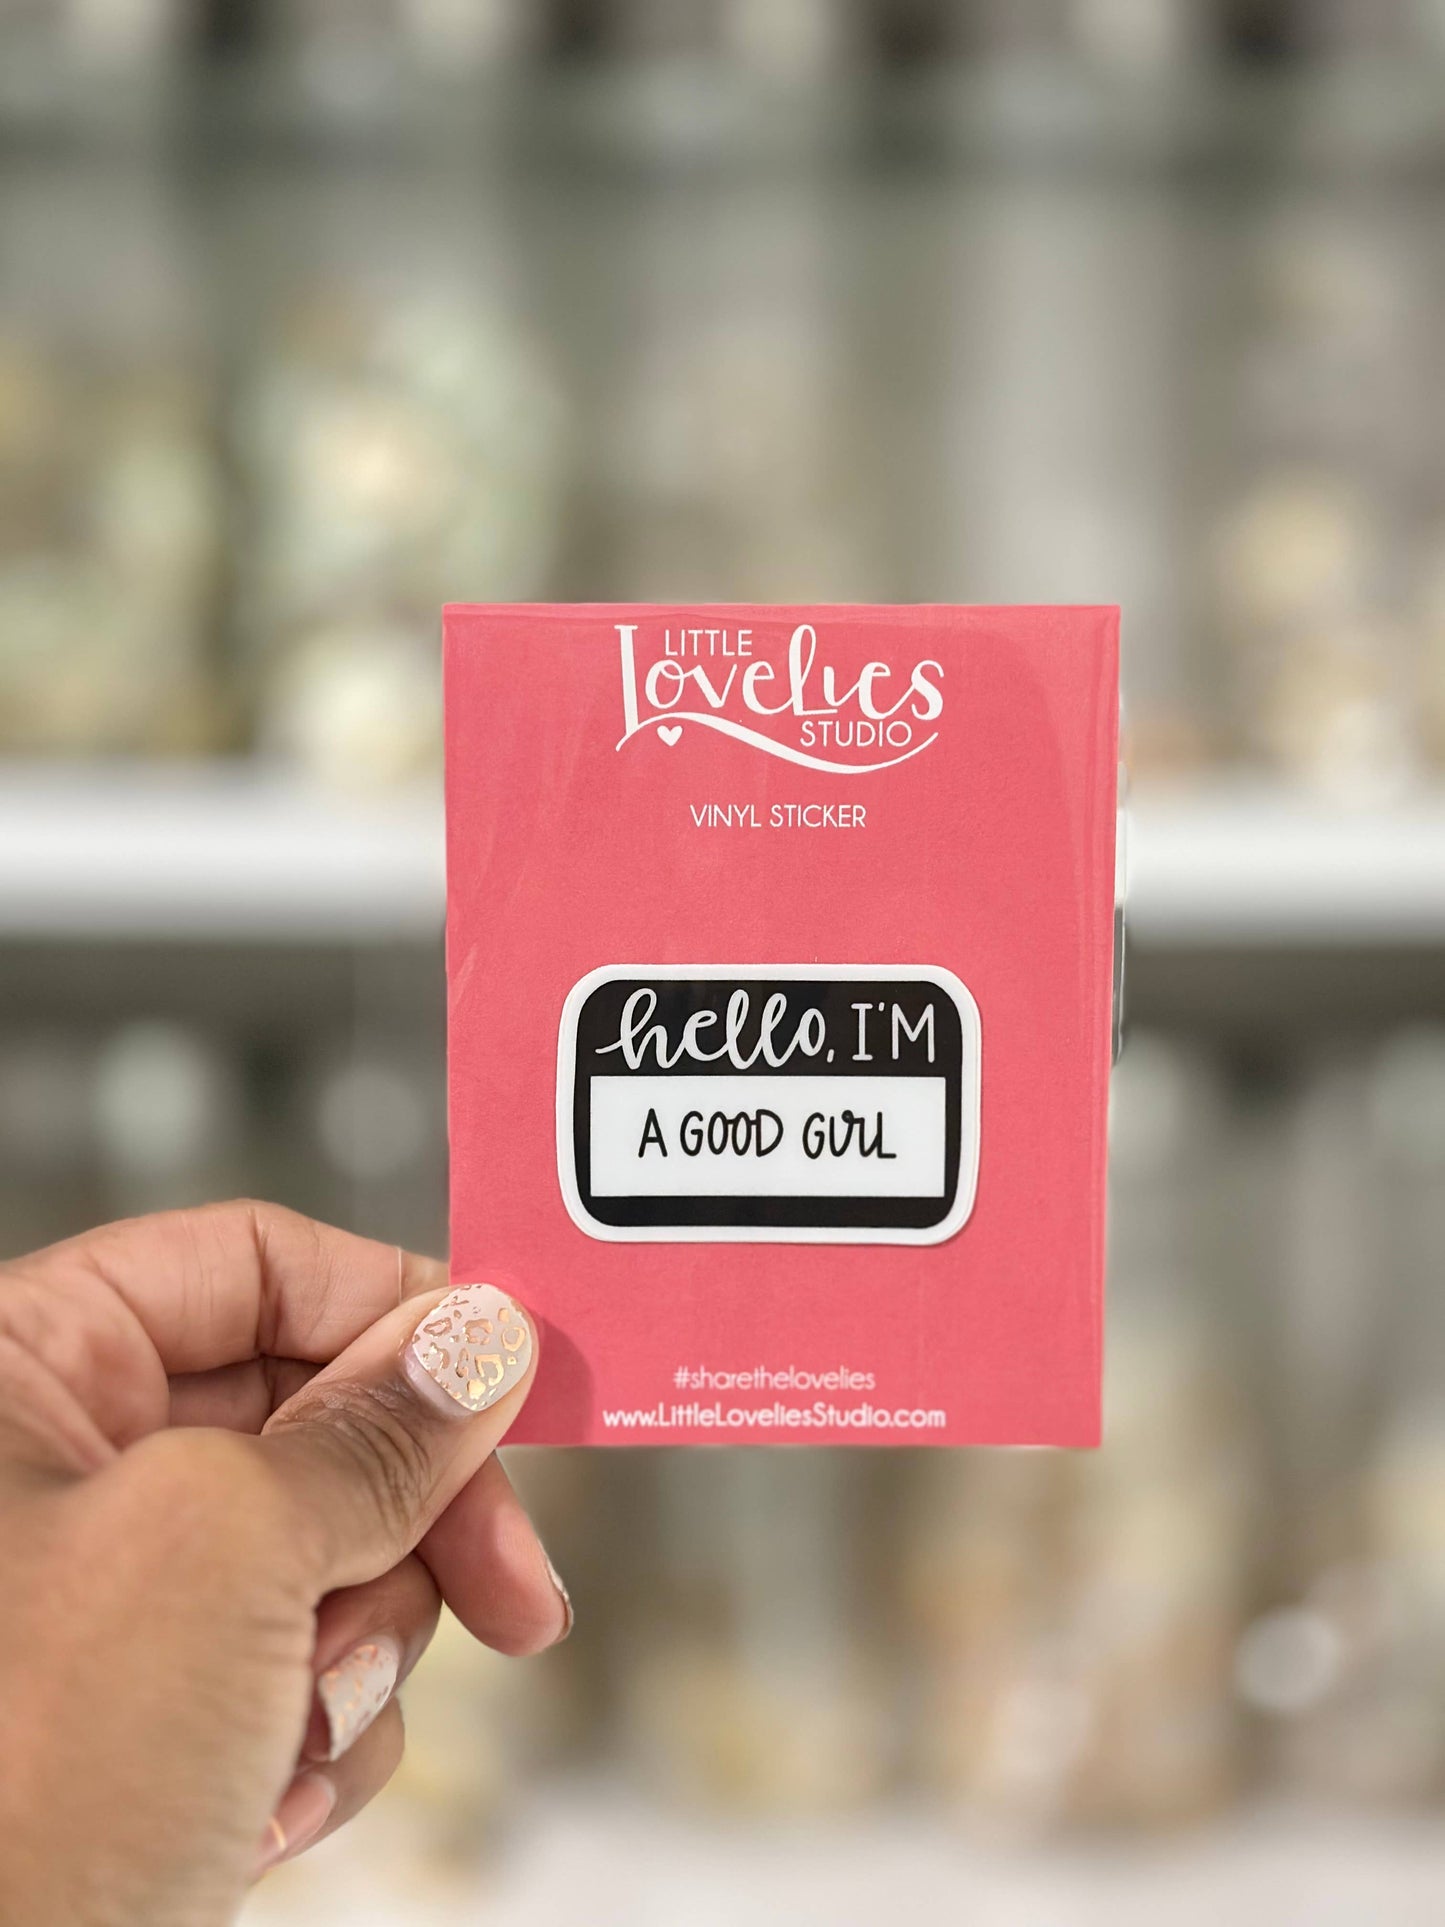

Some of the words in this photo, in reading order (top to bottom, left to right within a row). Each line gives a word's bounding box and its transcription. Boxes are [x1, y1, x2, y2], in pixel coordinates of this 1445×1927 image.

[664, 629, 753, 656] LITTLE
[614, 624, 944, 734] Lovelies
[800, 720, 912, 748] STUDIO
[690, 804, 761, 828] VINYL
[769, 804, 866, 828] STICKER
[595, 988, 836, 1070] hello,
[851, 1003, 935, 1063] I'M
[638, 1108, 668, 1158] A
[680, 1109, 784, 1158] GOOD
[673, 1365, 876, 1391] #sharethelovelies
[602, 1401, 947, 1429] www.LittleLoveliesStudio.com
